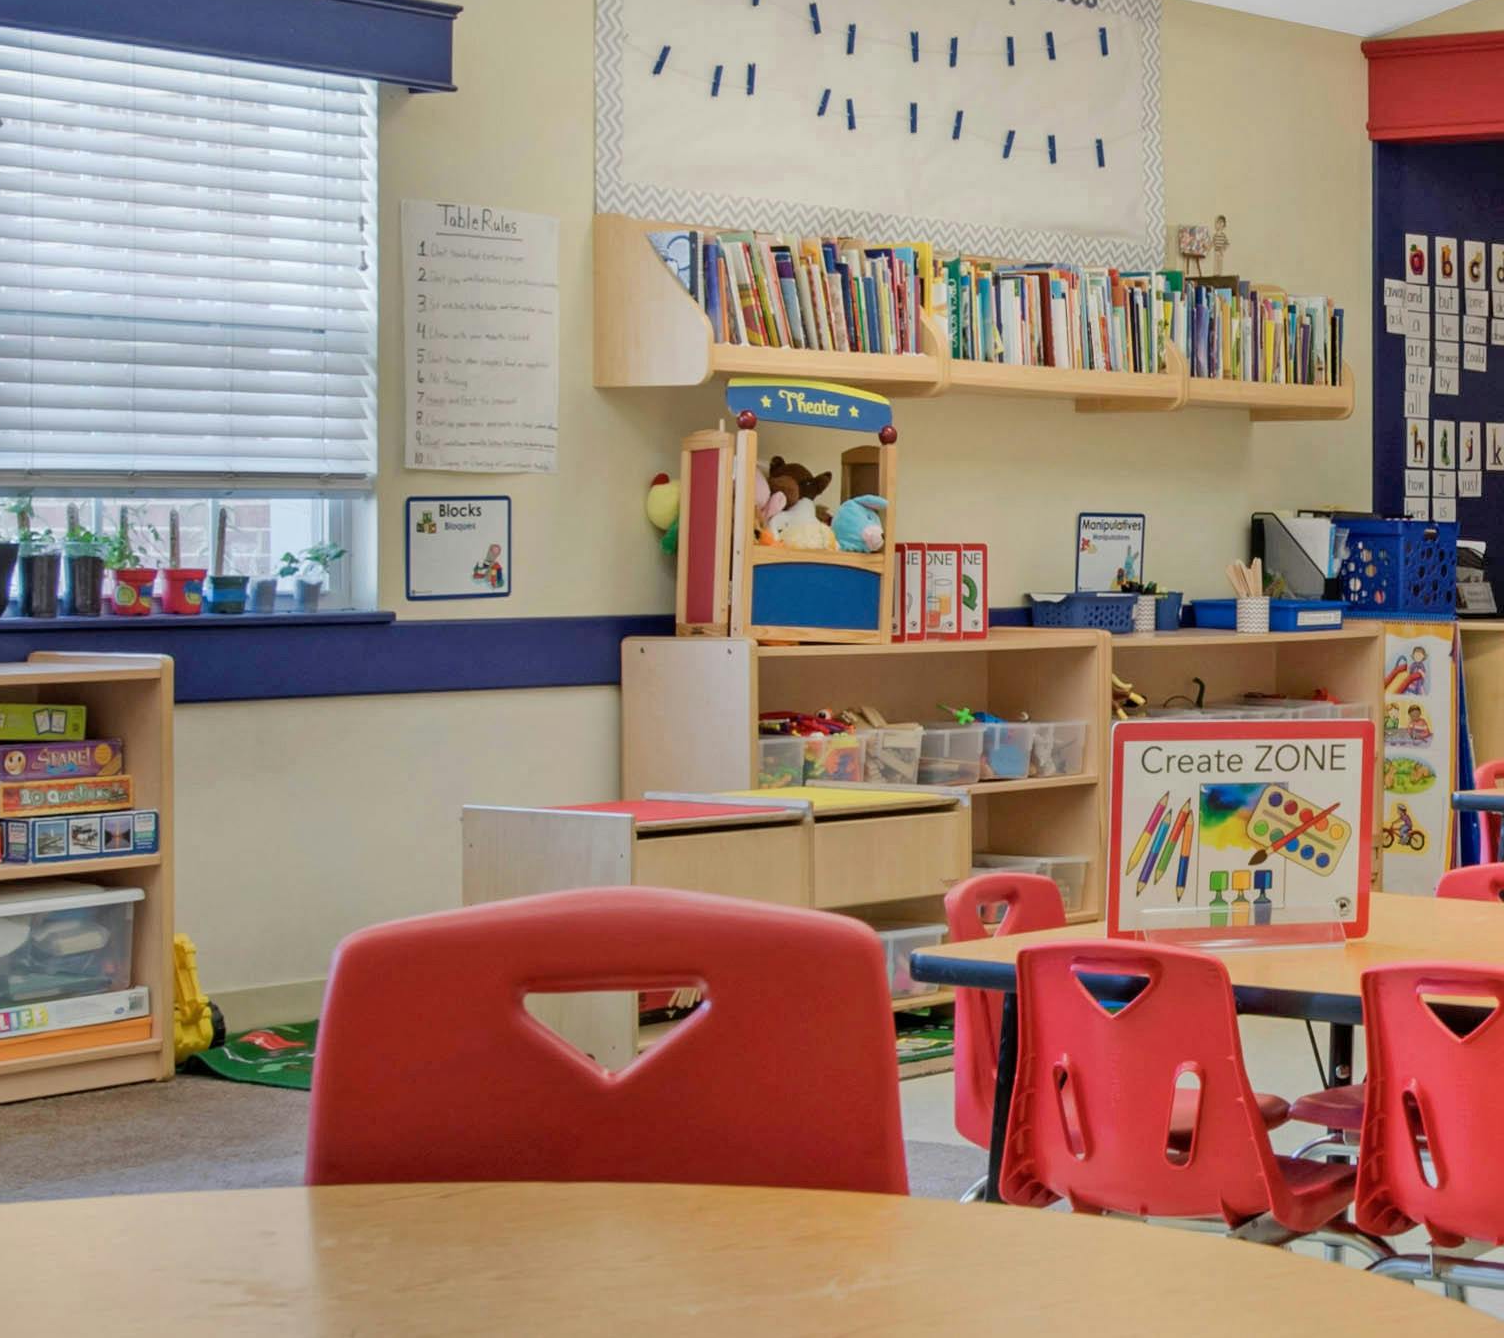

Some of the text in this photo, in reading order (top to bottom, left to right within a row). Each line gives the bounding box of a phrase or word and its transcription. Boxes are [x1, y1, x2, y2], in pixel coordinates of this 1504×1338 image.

[436, 203, 518, 234] Table Rules
[778, 389, 841, 417] Theater
[438, 503, 482, 518] Blocks
[1081, 518, 1142, 533] Manipulatives
[1140, 743, 1347, 774] Create ZONE
